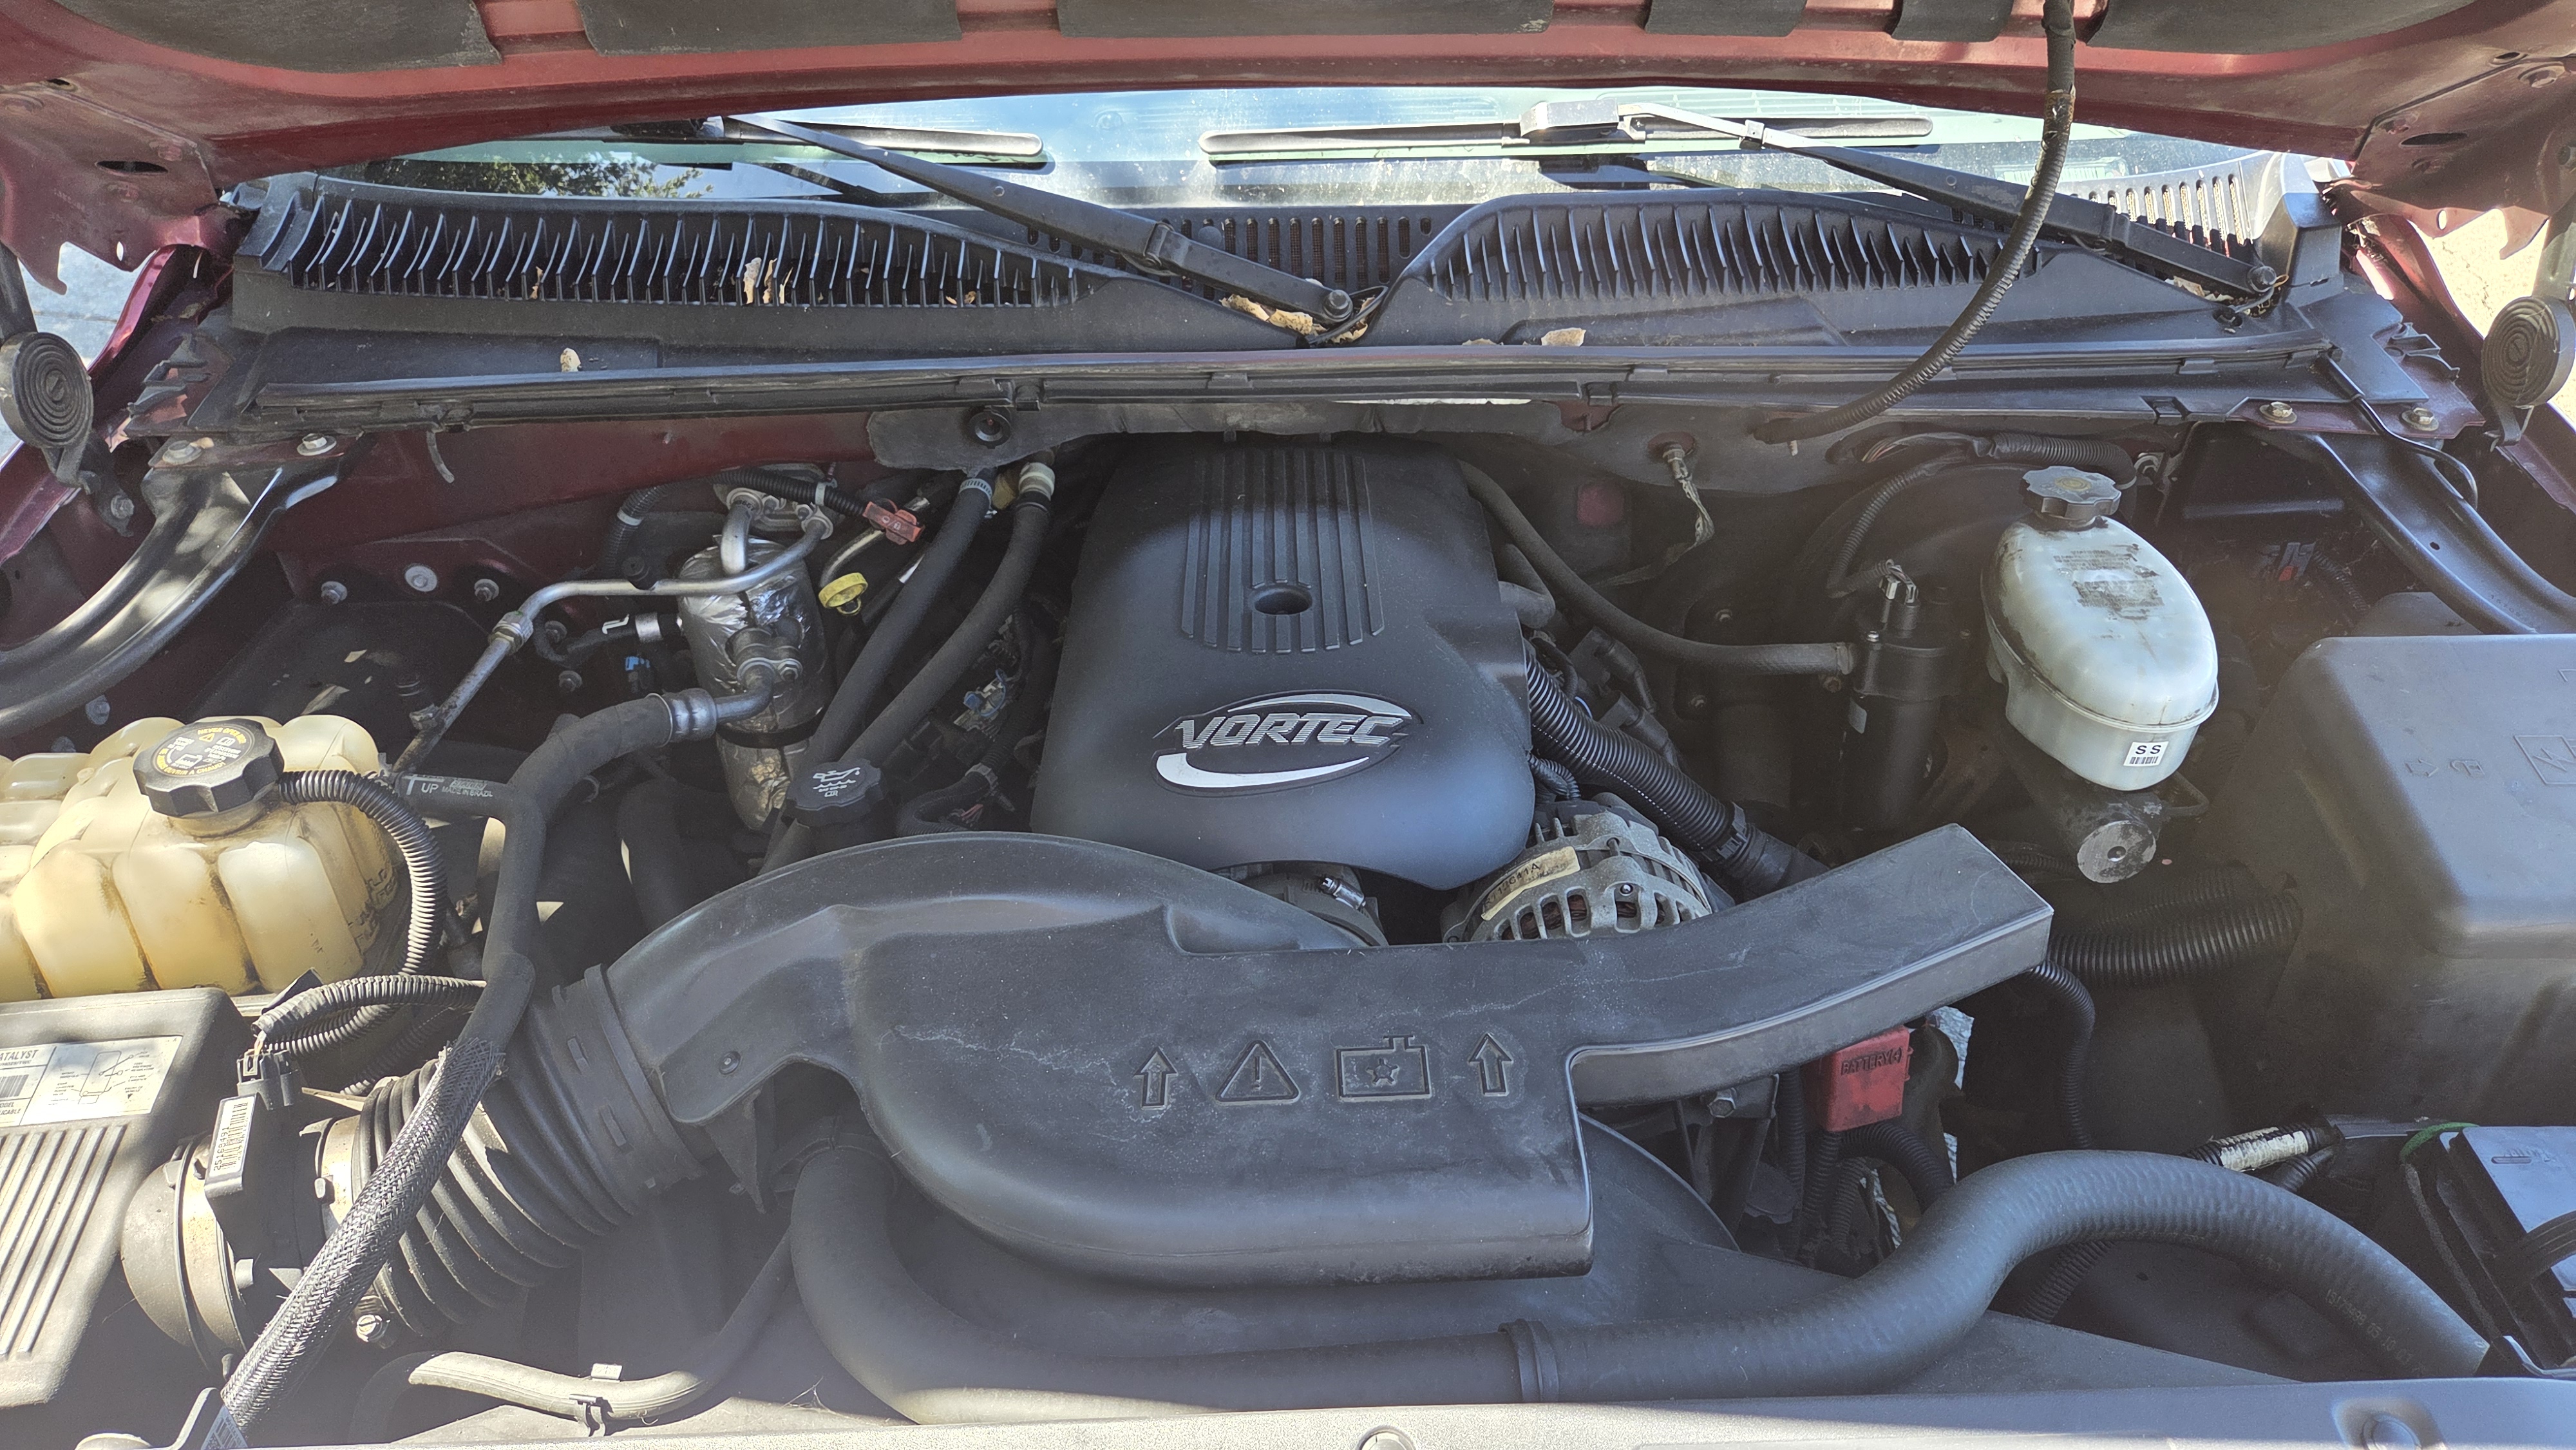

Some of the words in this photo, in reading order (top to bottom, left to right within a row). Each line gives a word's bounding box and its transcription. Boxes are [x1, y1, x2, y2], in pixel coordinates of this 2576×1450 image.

[1175, 713, 1404, 749] VORTEC
[421, 783, 439, 793] UP
[442, 786, 461, 795] MADE
